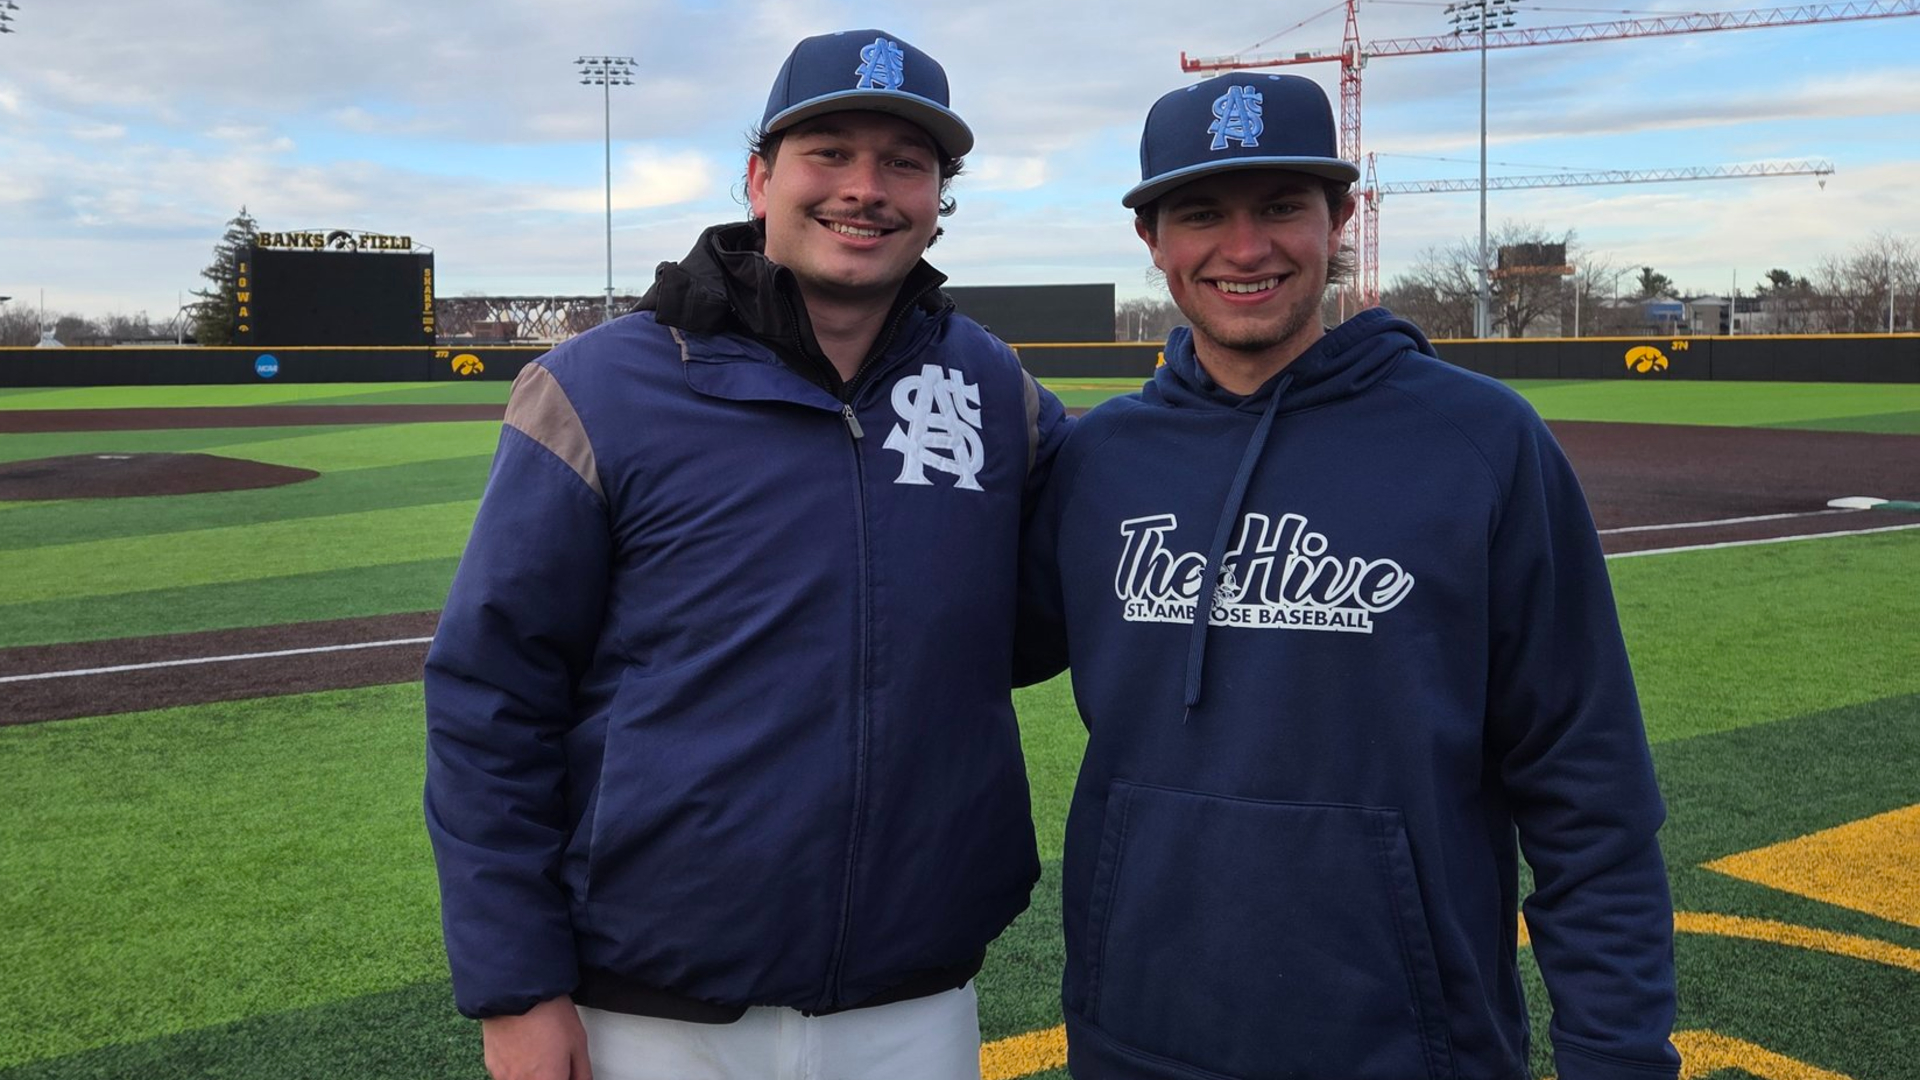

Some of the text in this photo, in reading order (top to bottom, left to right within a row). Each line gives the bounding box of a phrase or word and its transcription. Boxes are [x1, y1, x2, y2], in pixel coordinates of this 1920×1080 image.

[259, 232, 411, 250] BANKS FIELD
[236, 262, 250, 317] IOWA
[423, 268, 431, 311] SHARP
[1115, 512, 1415, 613] The Hive
[1126, 602, 1368, 629] ST. AMBOSE BASEBALL
